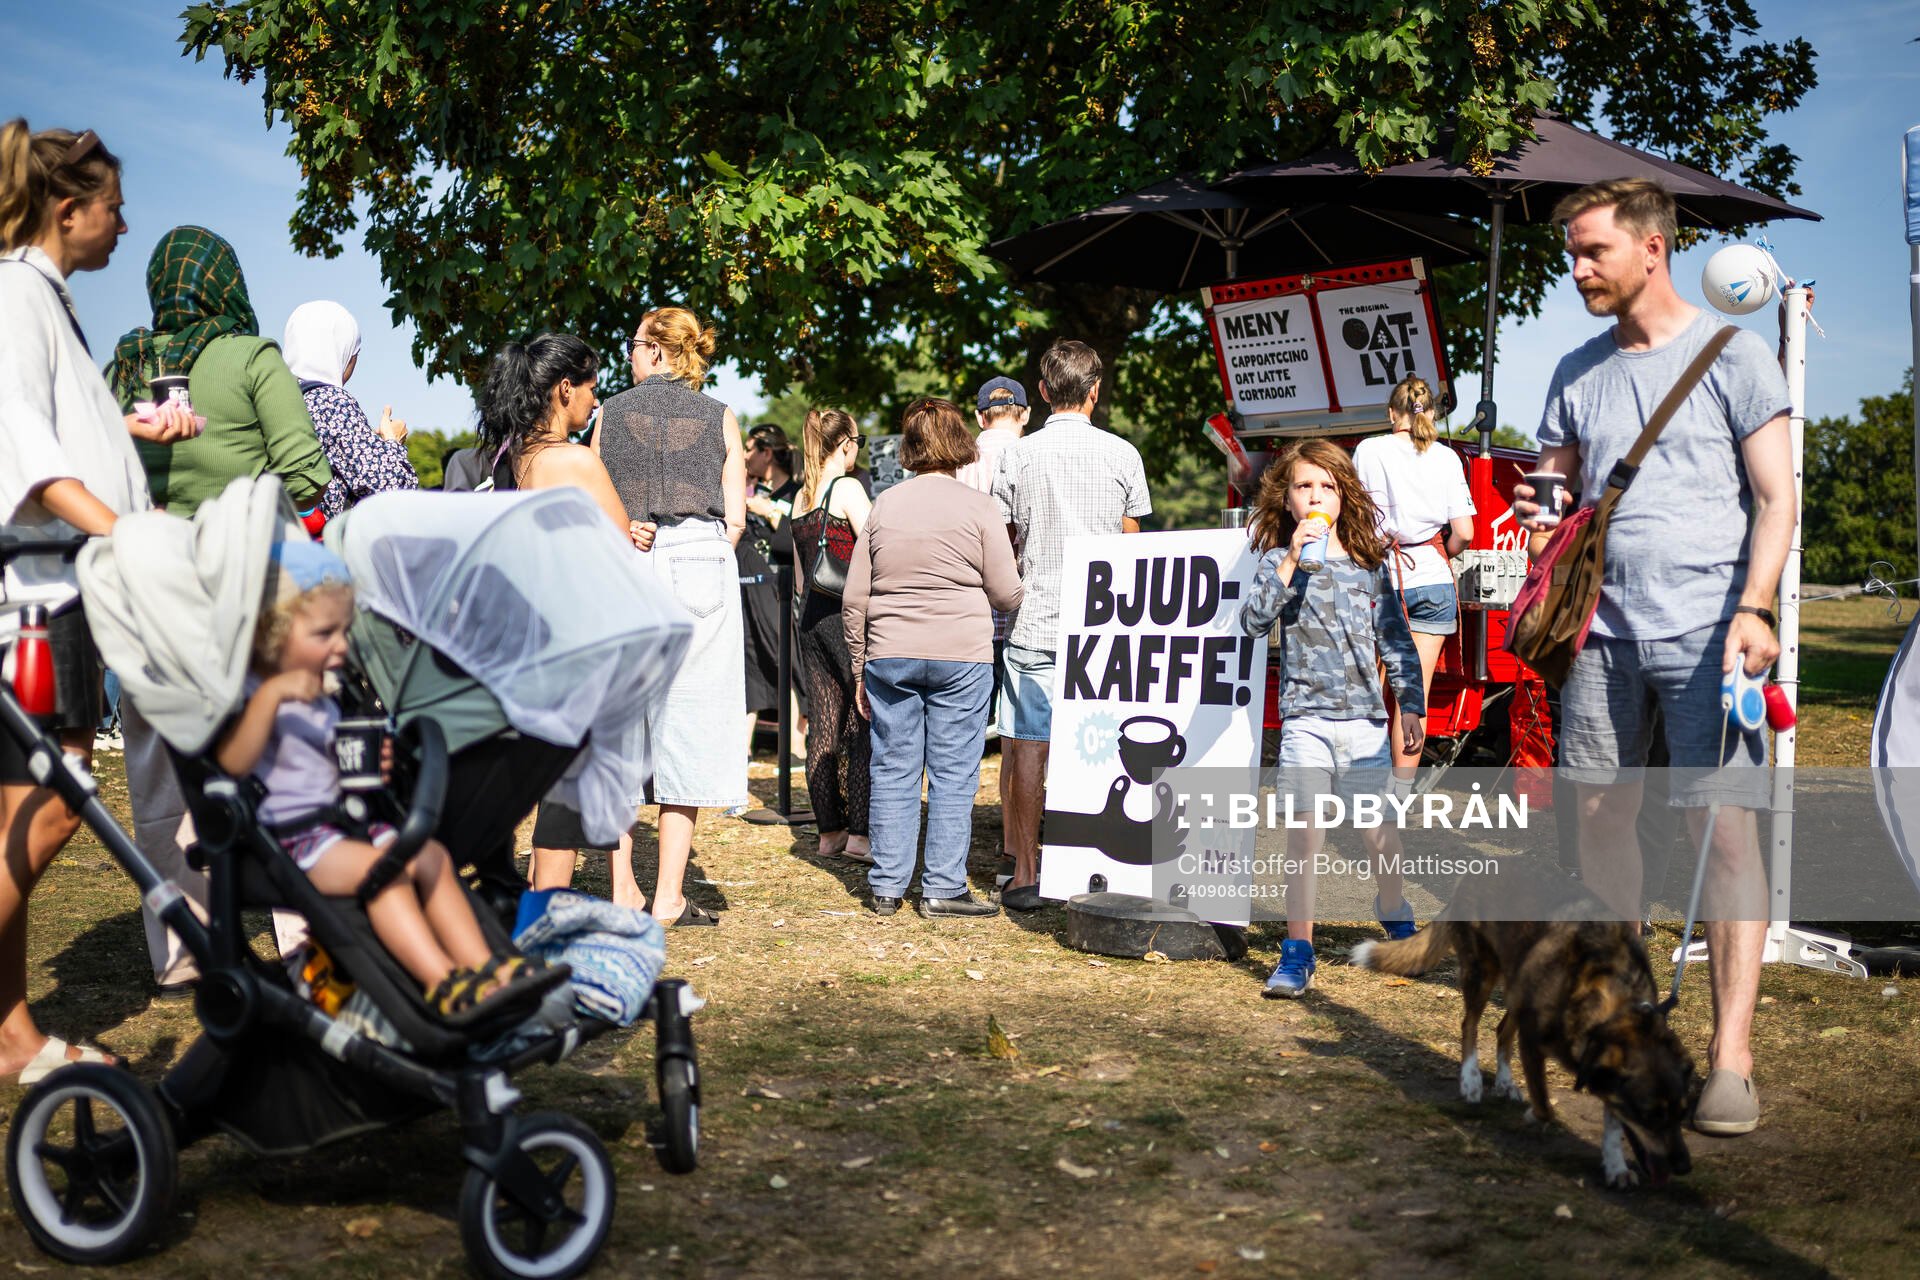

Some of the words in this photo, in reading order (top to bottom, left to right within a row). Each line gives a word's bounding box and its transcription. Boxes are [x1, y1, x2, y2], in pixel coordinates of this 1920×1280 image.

[1338, 307, 1354, 315] THE
[1355, 303, 1390, 313] ORIGINAL
[1222, 309, 1290, 340] MENY
[1342, 311, 1418, 352] OAT-
[1231, 349, 1309, 368] CAPPOATCCINO
[1235, 372, 1255, 385] OAT
[1257, 369, 1291, 383] LATTE
[1239, 385, 1297, 402] CORTADOAT
[1084, 556, 1240, 627] BJUD-
[1064, 635, 1255, 706] KAFFE!
